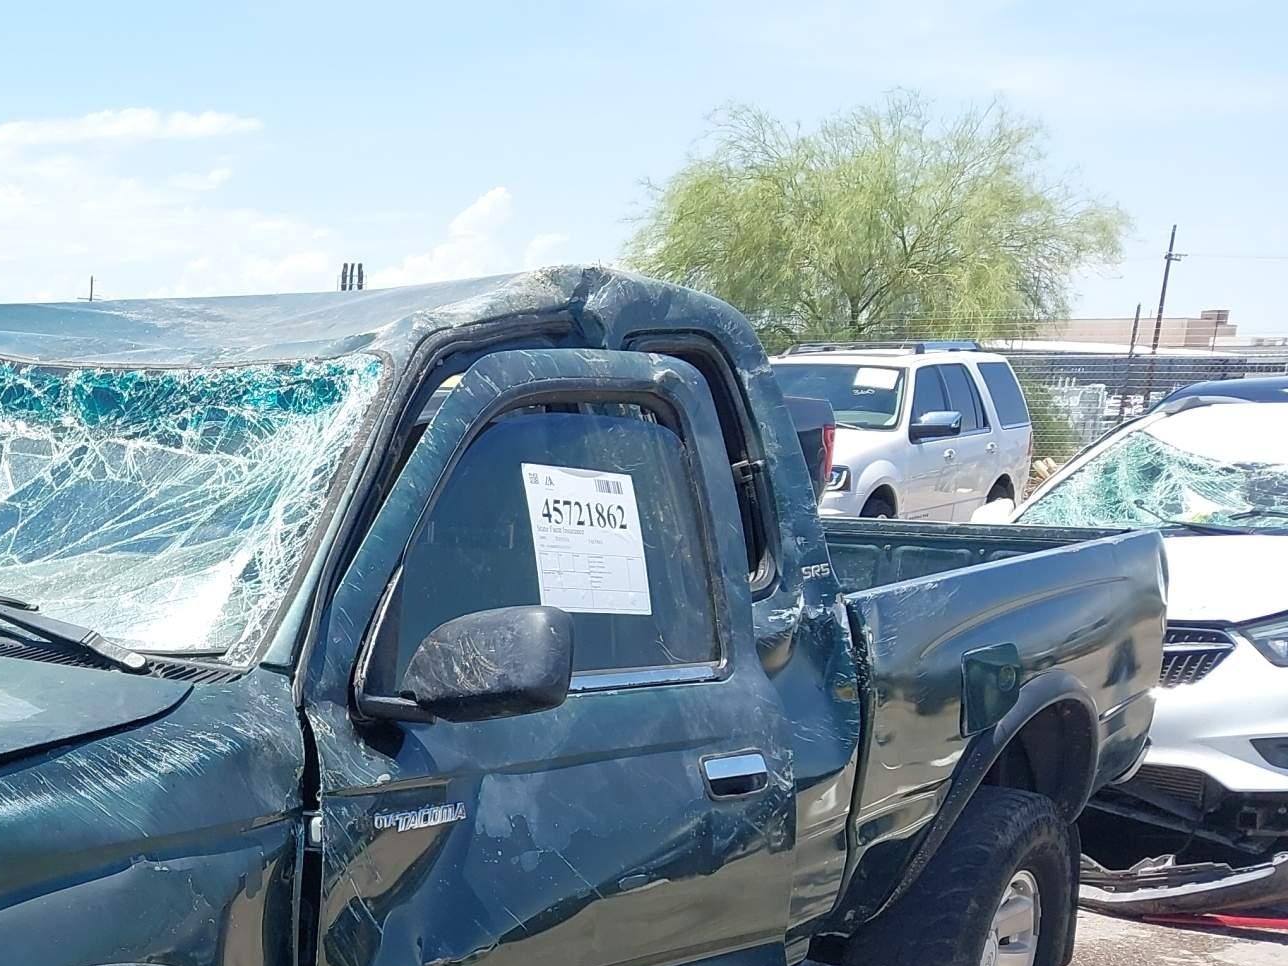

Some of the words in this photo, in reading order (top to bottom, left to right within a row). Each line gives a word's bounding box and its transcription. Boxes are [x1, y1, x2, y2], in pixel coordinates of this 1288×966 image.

[542, 498, 628, 530] 45721862
[801, 563, 830, 580] SR5
[396, 802, 467, 833] TACOMA
